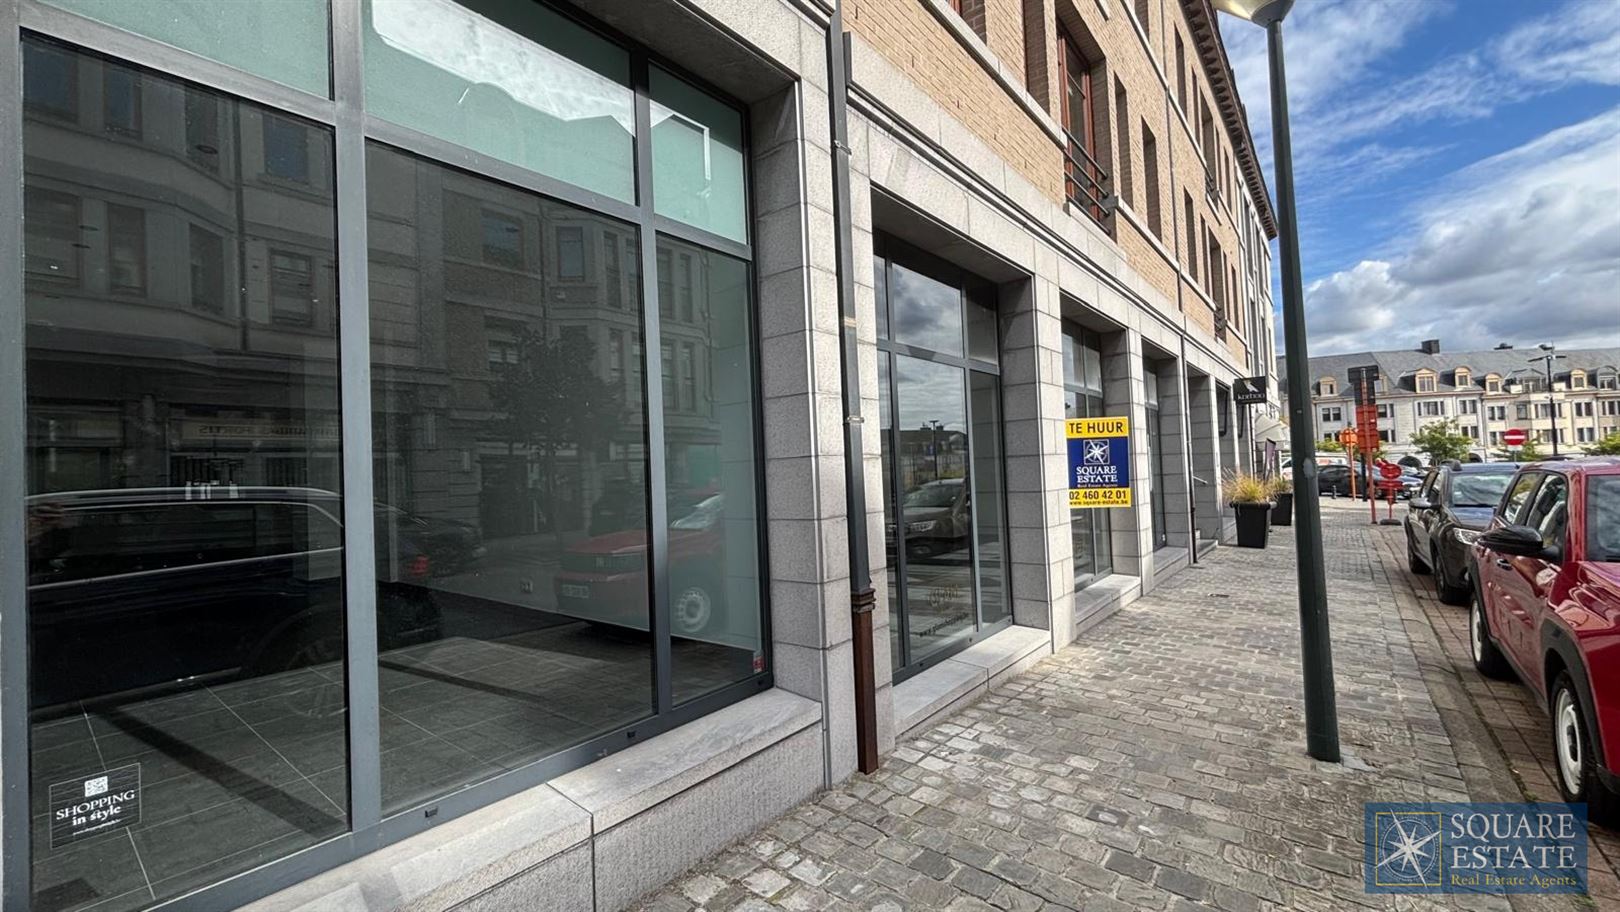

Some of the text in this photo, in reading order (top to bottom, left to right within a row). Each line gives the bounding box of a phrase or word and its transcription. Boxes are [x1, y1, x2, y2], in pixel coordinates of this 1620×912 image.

[1069, 422, 1123, 434] TE HUUR
[1076, 466, 1117, 475] SQUARE
[1077, 475, 1118, 483] ESTATE
[1069, 490, 1127, 500] 02 460 42 01
[56, 790, 135, 820] SHOPPING
[72, 805, 122, 826] in style
